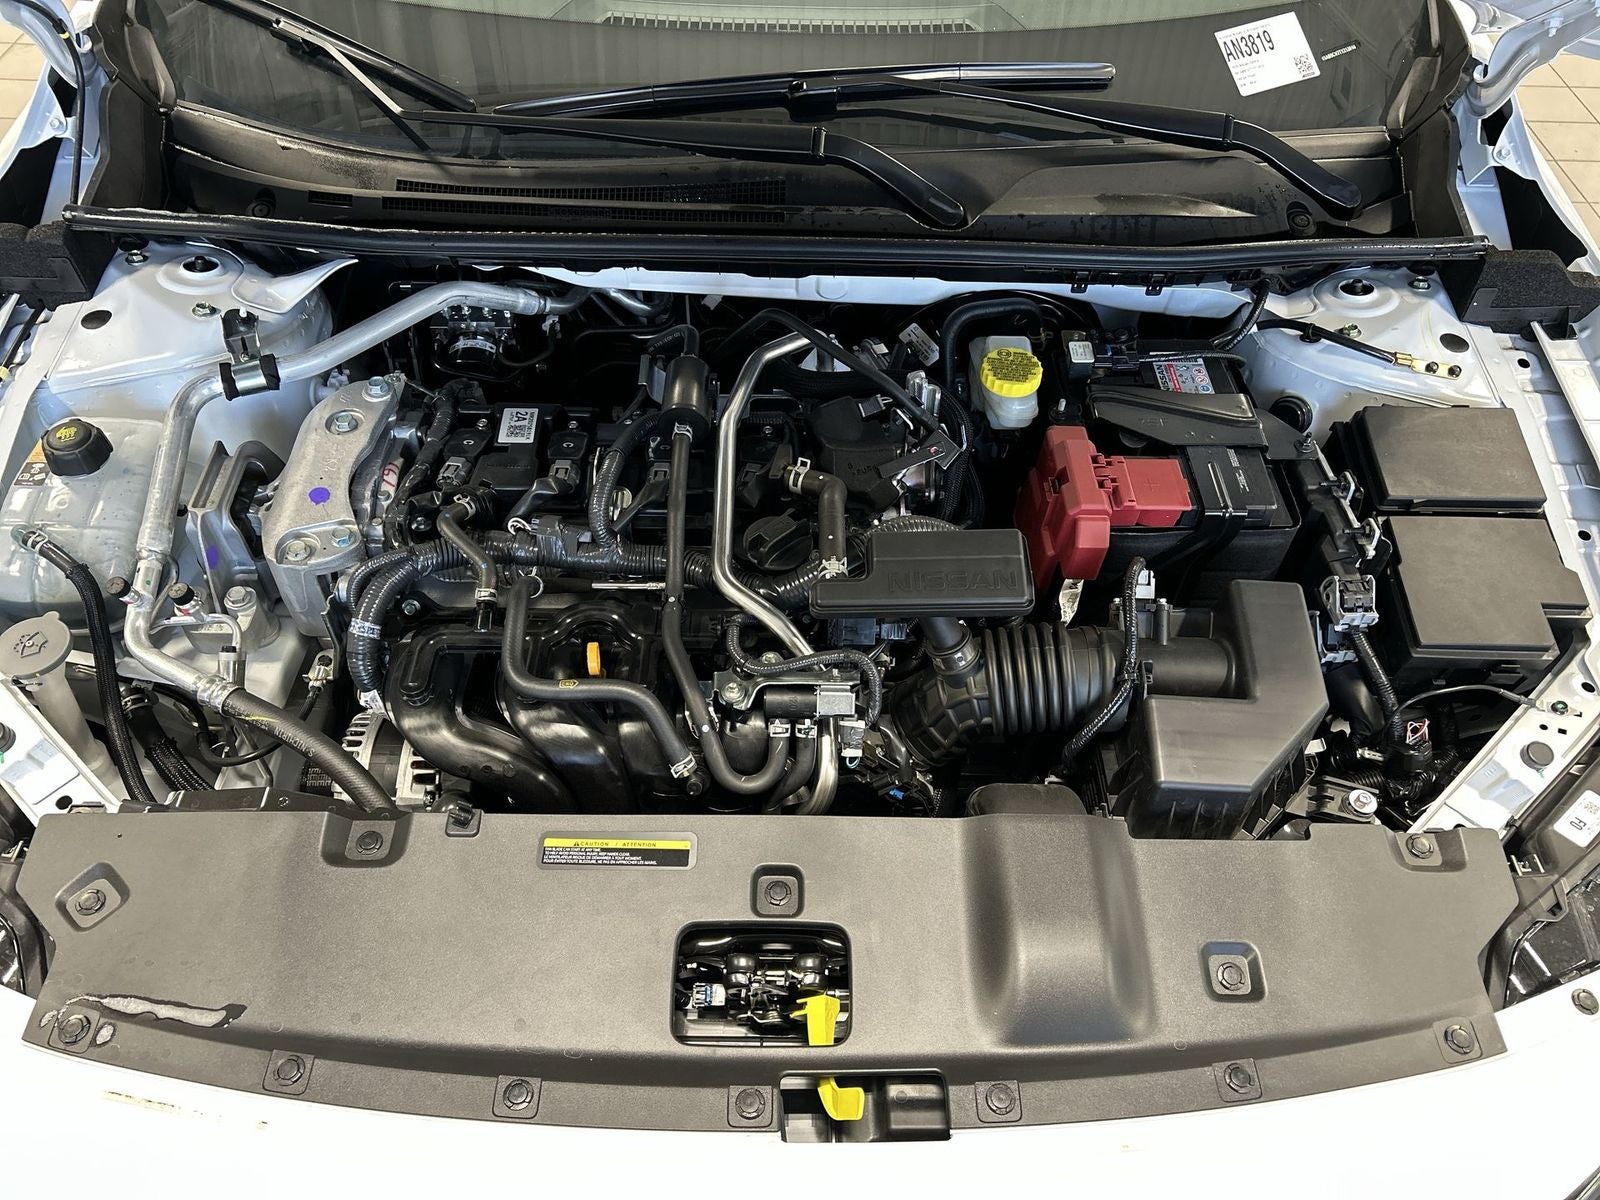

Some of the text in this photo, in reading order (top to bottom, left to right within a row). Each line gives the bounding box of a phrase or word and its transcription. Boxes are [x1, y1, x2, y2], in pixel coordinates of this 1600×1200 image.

[1222, 29, 1275, 62] AN3819
[514, 411, 528, 423] 2A
[888, 569, 1017, 592] NISSAN
